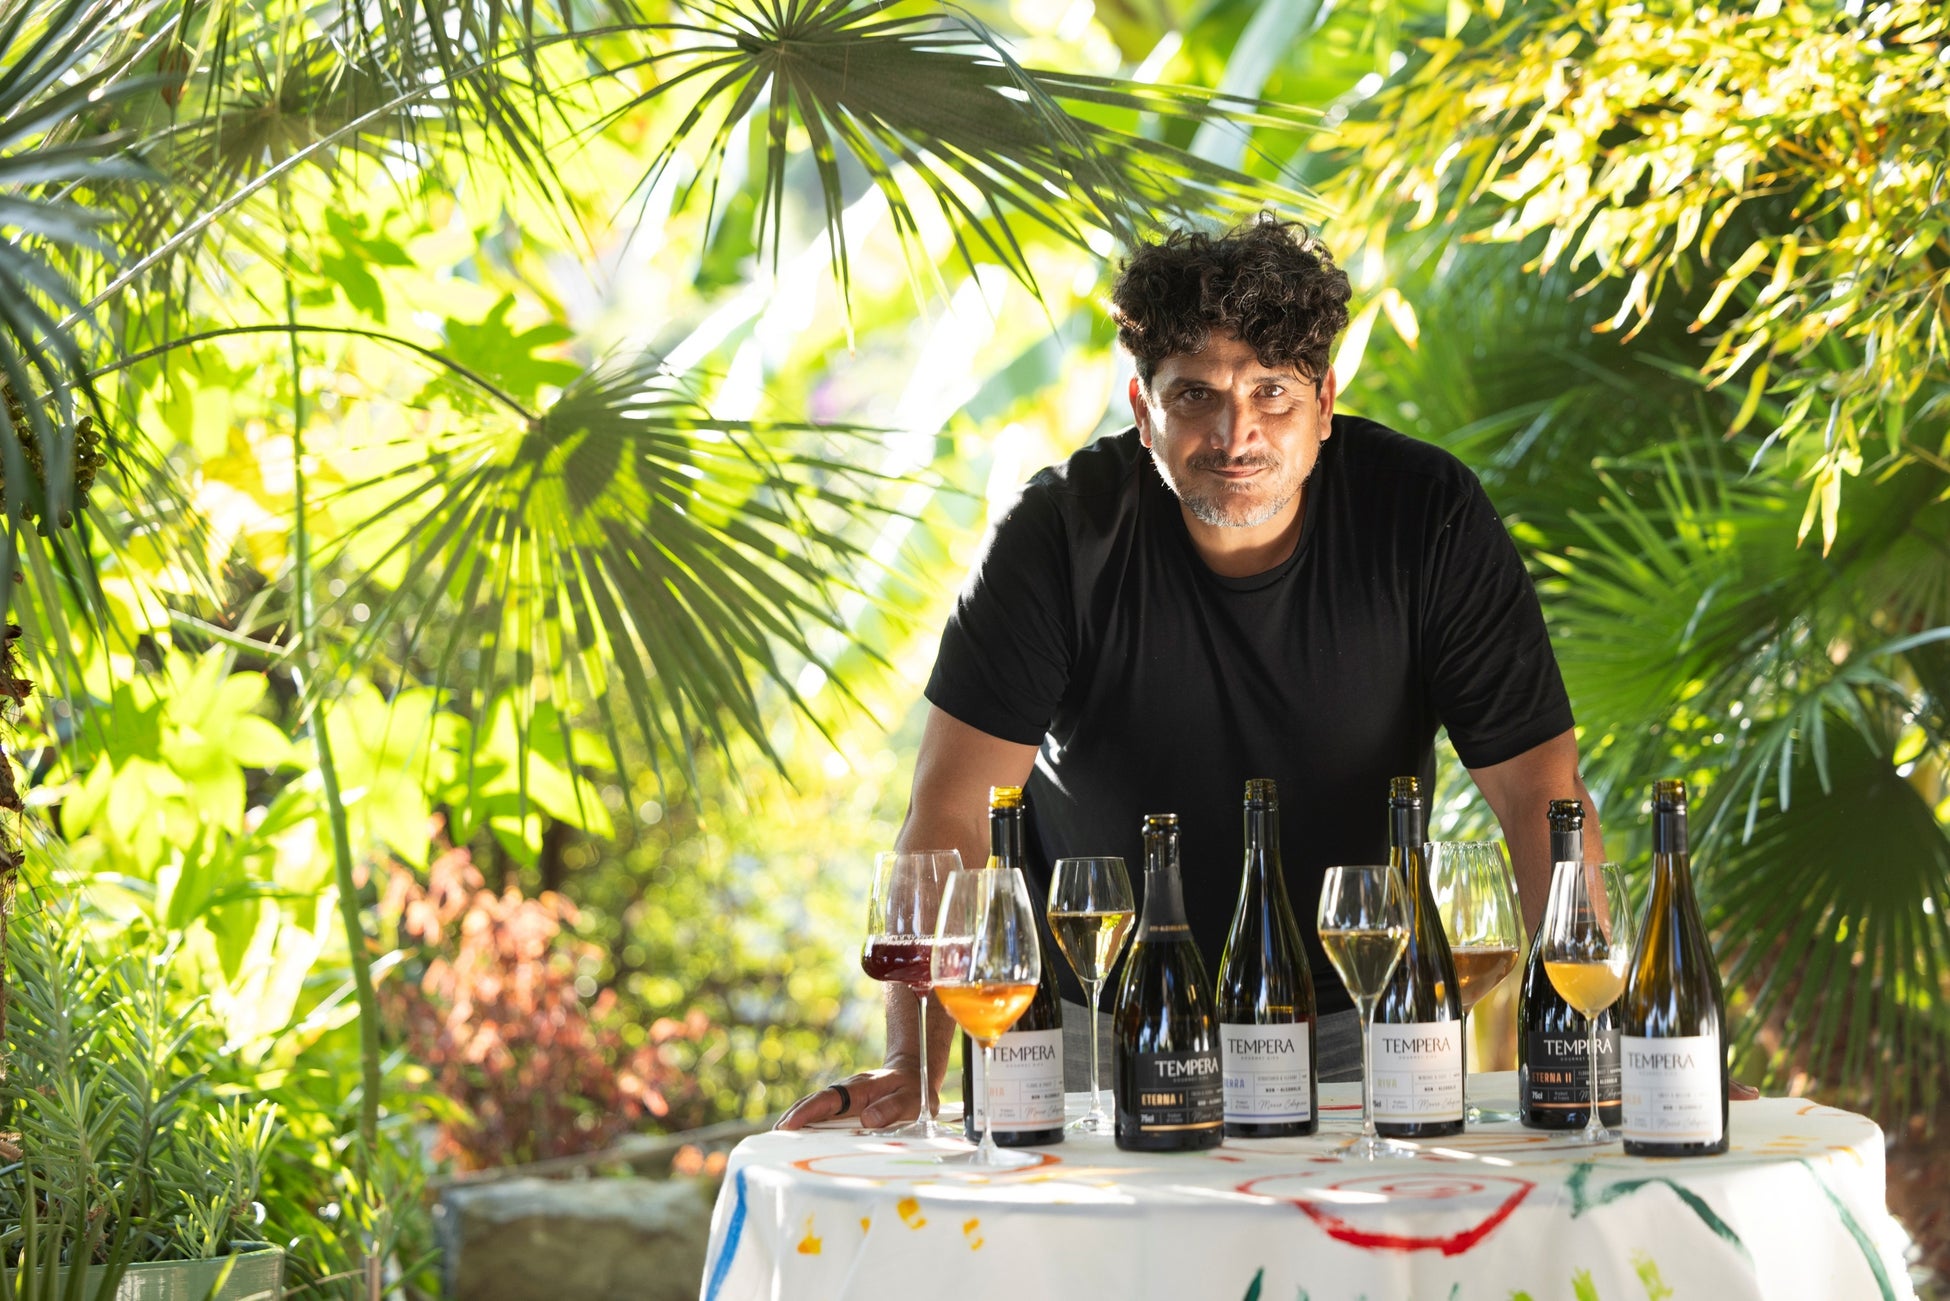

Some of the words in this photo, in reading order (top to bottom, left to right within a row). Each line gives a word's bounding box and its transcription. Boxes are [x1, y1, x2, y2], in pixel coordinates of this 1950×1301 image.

[992, 1045, 1056, 1062] TEMPERA
[1227, 1038, 1295, 1054] TEMPERA
[1382, 1037, 1450, 1054] TEMPERA
[1154, 1057, 1219, 1078] TEMPERA
[1627, 1051, 1694, 1069] TEMPERA
[1377, 1078, 1397, 1089] RIVA
[1532, 1072, 1561, 1083] ETERNA
[1565, 1071, 1572, 1084] II
[1141, 1093, 1177, 1106] ETERNA
[1179, 1093, 1183, 1105] I
